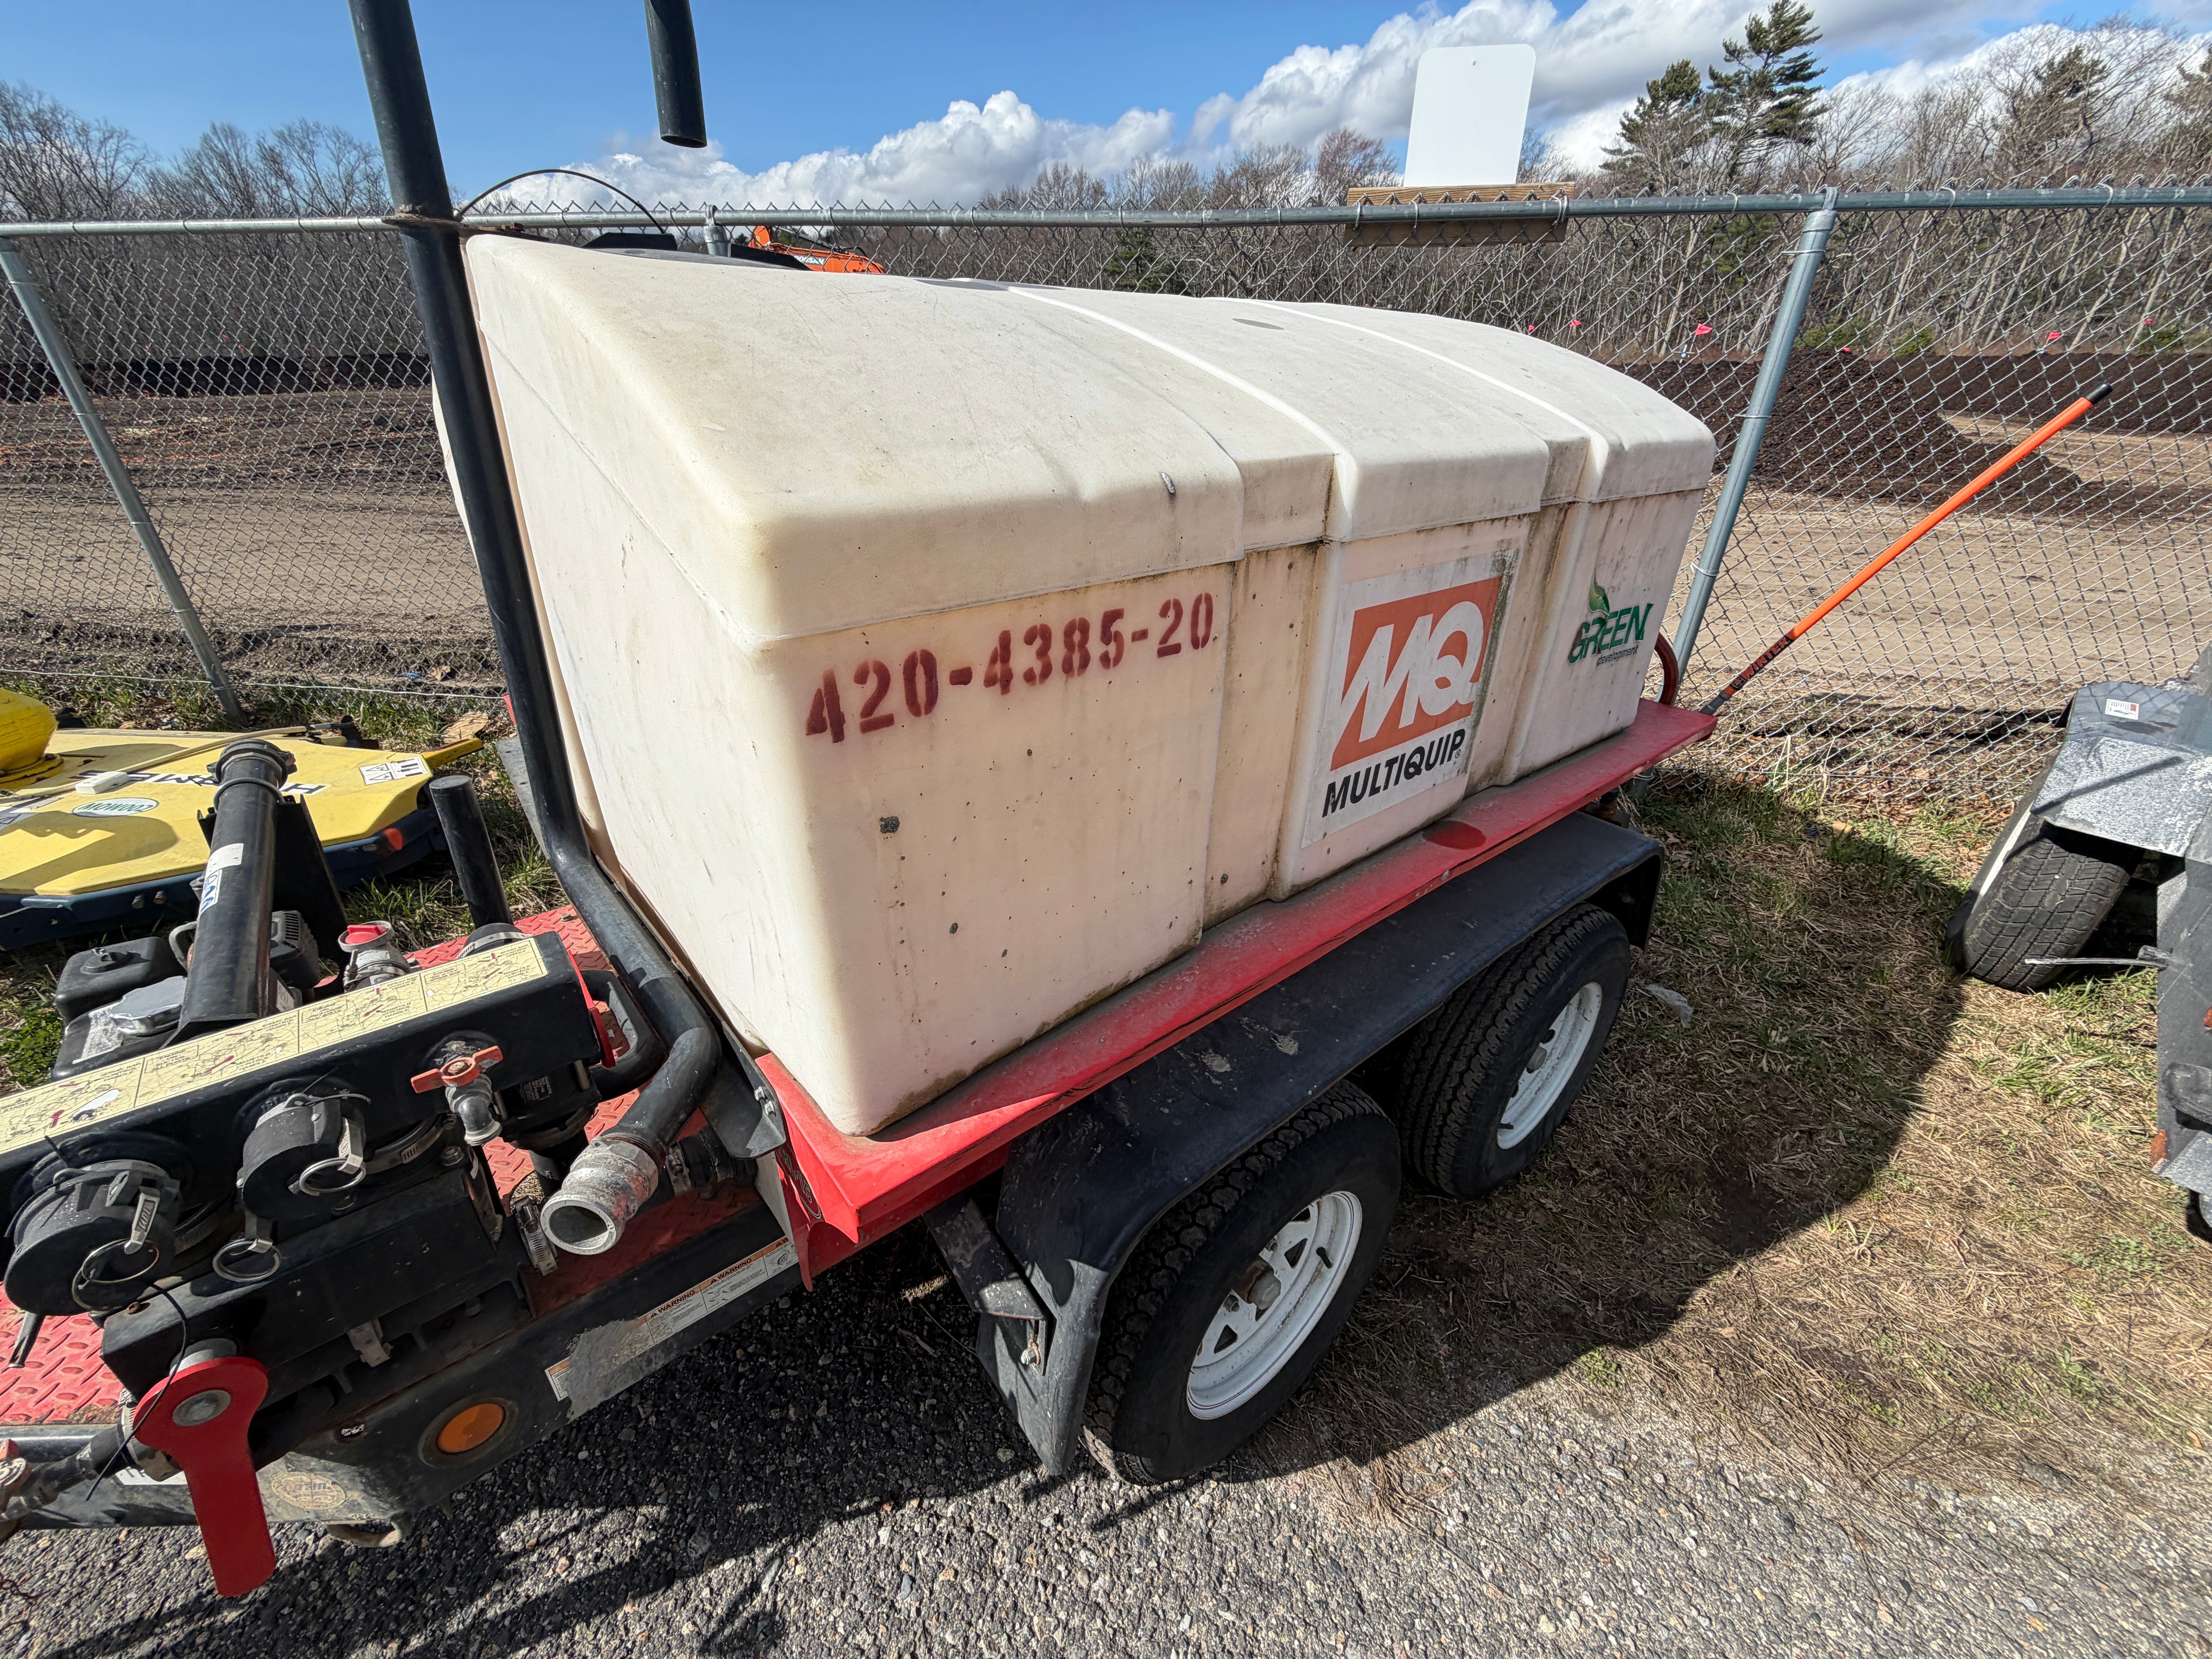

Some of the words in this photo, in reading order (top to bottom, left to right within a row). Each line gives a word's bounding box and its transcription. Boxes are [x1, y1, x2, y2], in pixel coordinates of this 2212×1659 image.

[1568, 603, 1654, 665] GREEN
[1741, 636, 1790, 680] WINTER
[805, 592, 1214, 744] 420-4385-20
[1341, 601, 1484, 743] MQ
[1321, 728, 1466, 818] MULTIQUIP
[717, 1258, 752, 1279] WARNING
[658, 1290, 696, 1313] WARNING
